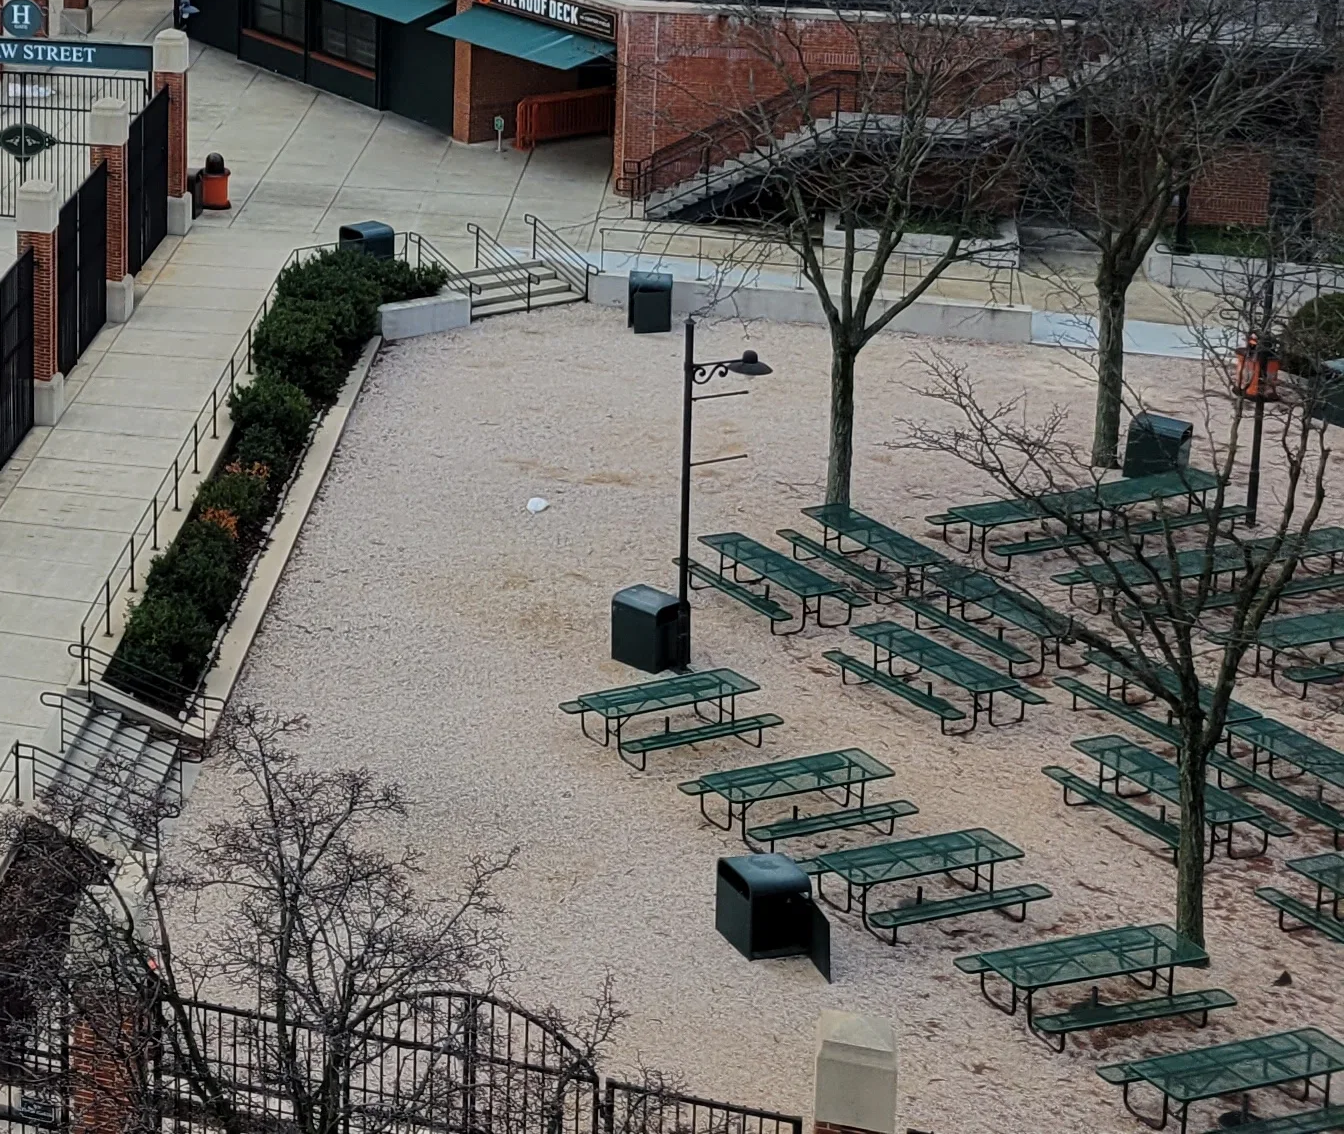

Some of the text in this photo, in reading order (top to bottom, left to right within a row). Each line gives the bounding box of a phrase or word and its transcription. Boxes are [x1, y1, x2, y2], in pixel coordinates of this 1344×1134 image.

[11, 4, 30, 25] H
[549, 0, 579, 26] DECK
[22, 44, 96, 64] STREET
